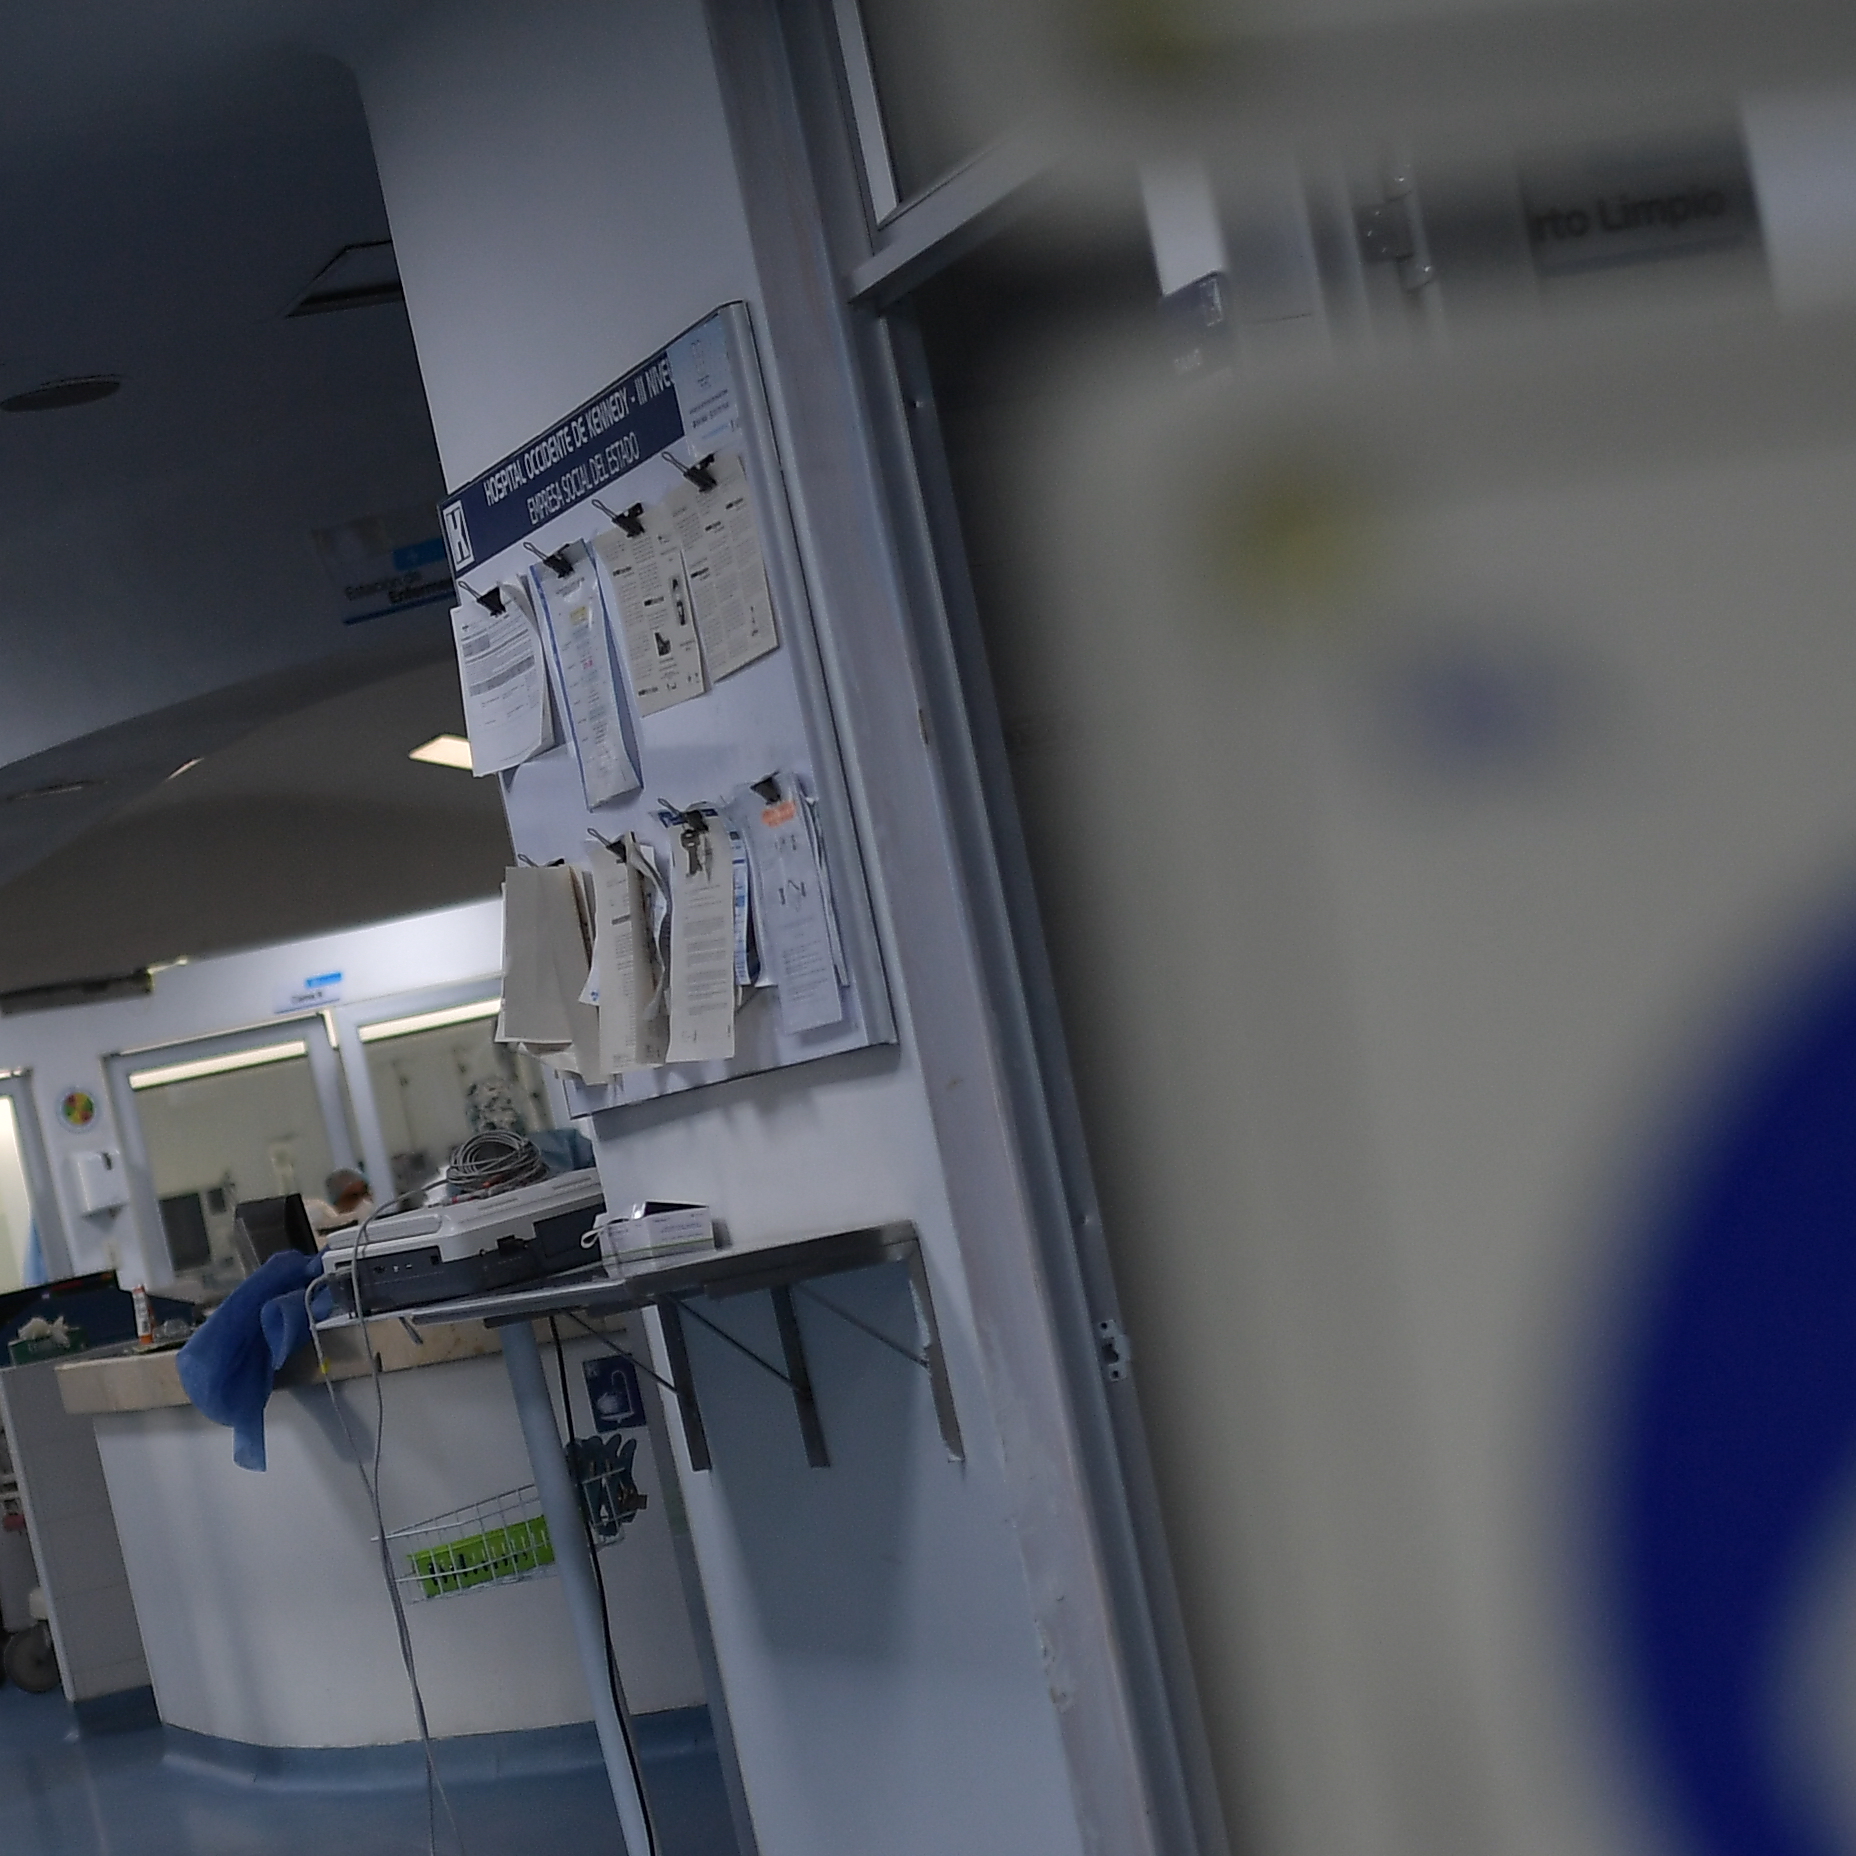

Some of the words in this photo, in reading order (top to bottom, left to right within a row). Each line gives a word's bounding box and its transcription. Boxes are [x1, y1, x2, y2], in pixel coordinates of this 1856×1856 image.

[1528, 207, 1589, 242] rto
[482, 453, 528, 507] HOSPITAL
[524, 425, 574, 480] OCCIDENTE
[570, 416, 588, 448] DE
[585, 386, 630, 439] KENNEDY
[526, 481, 566, 526] EMPRESA
[561, 463, 593, 504] SOCIAL
[588, 453, 610, 486] DEL
[604, 431, 641, 476] ESTADO
